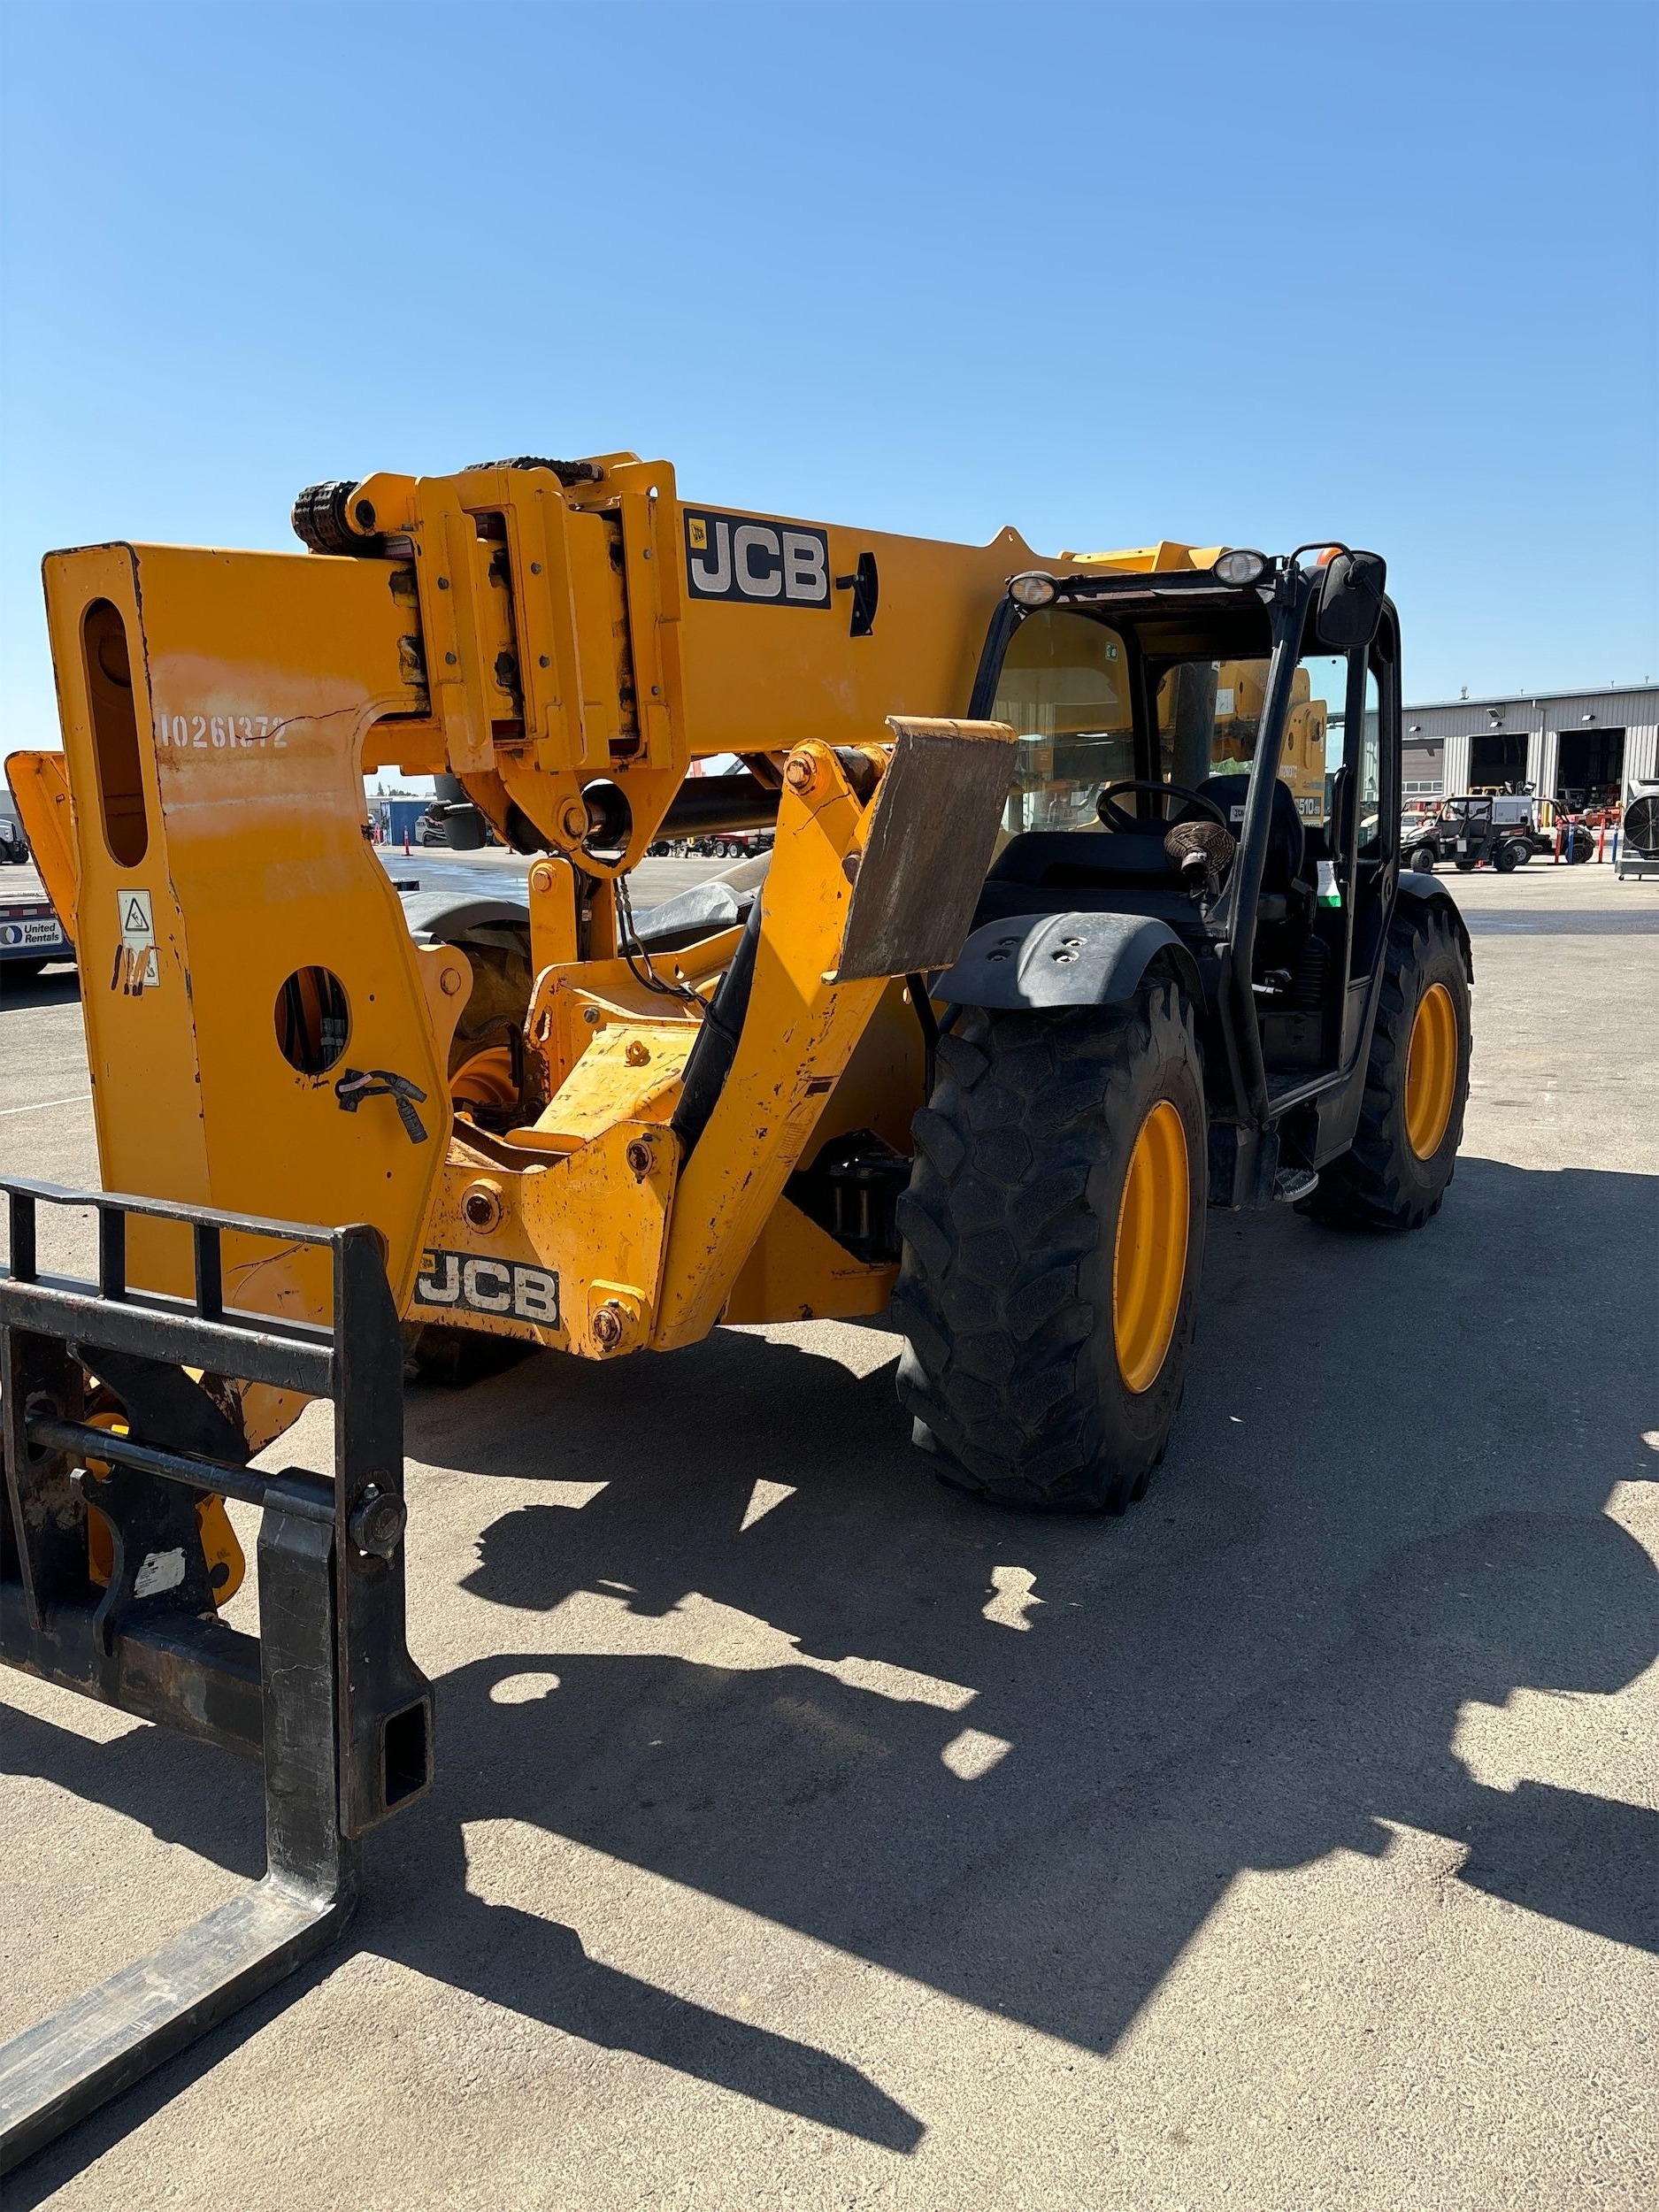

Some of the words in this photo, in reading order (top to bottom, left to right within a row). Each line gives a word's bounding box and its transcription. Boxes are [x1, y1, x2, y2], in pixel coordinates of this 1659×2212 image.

[691, 521, 827, 601] JCB
[160, 713, 288, 749] 10261372
[24, 923, 56, 933] United
[25, 932, 59, 943] Rentals
[419, 1256, 557, 1322] JCB
